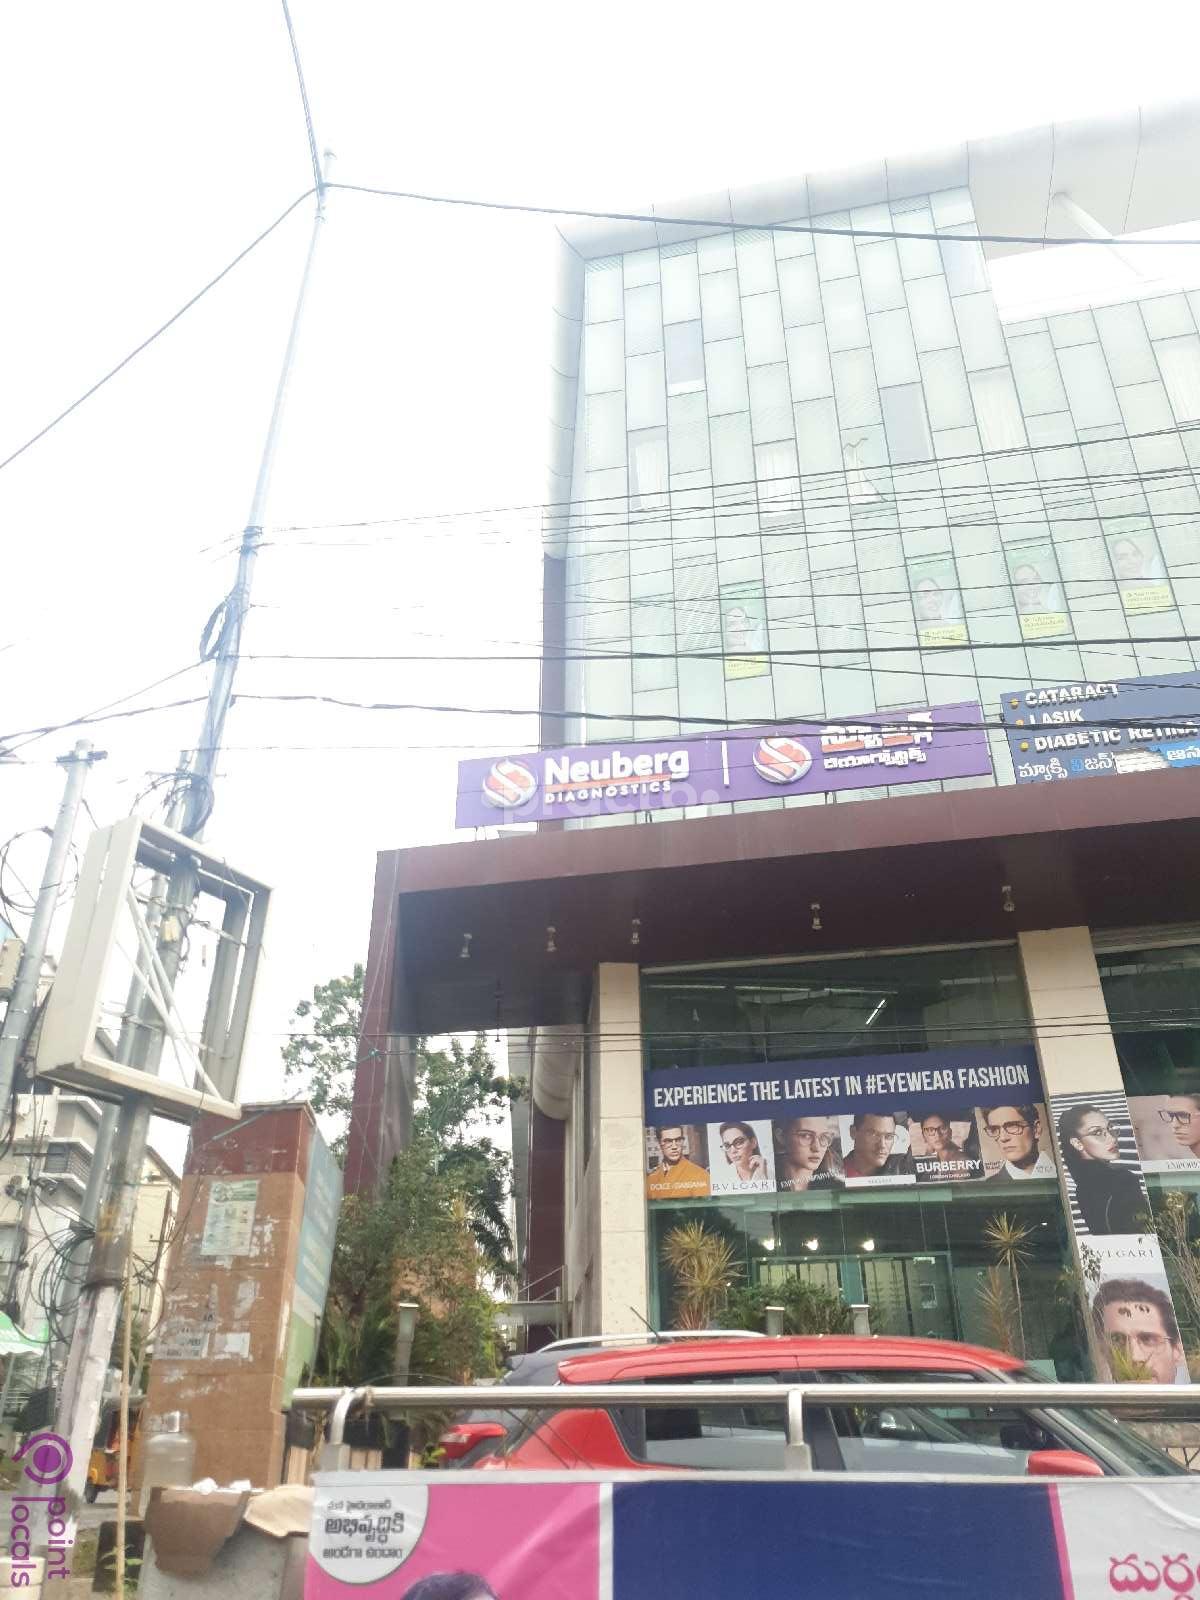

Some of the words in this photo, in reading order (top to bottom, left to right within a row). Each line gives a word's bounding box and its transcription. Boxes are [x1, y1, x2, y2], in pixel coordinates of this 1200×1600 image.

[1026, 683, 1119, 707] CATARACT
[1035, 730, 1122, 752] DIABETIC
[544, 750, 690, 785] Neuberg
[544, 780, 672, 804] DIAGNOSTICS
[654, 1082, 748, 1108] EXPERIENCE
[752, 1079, 781, 1100] THE
[784, 1076, 841, 1099] LATEST
[845, 1075, 862, 1095] IN
[866, 1070, 955, 1095] #EYEWEAR
[958, 1064, 1030, 1088] FASHION
[915, 1158, 981, 1174] BURBERRY
[711, 1179, 776, 1193] BVLGARI
